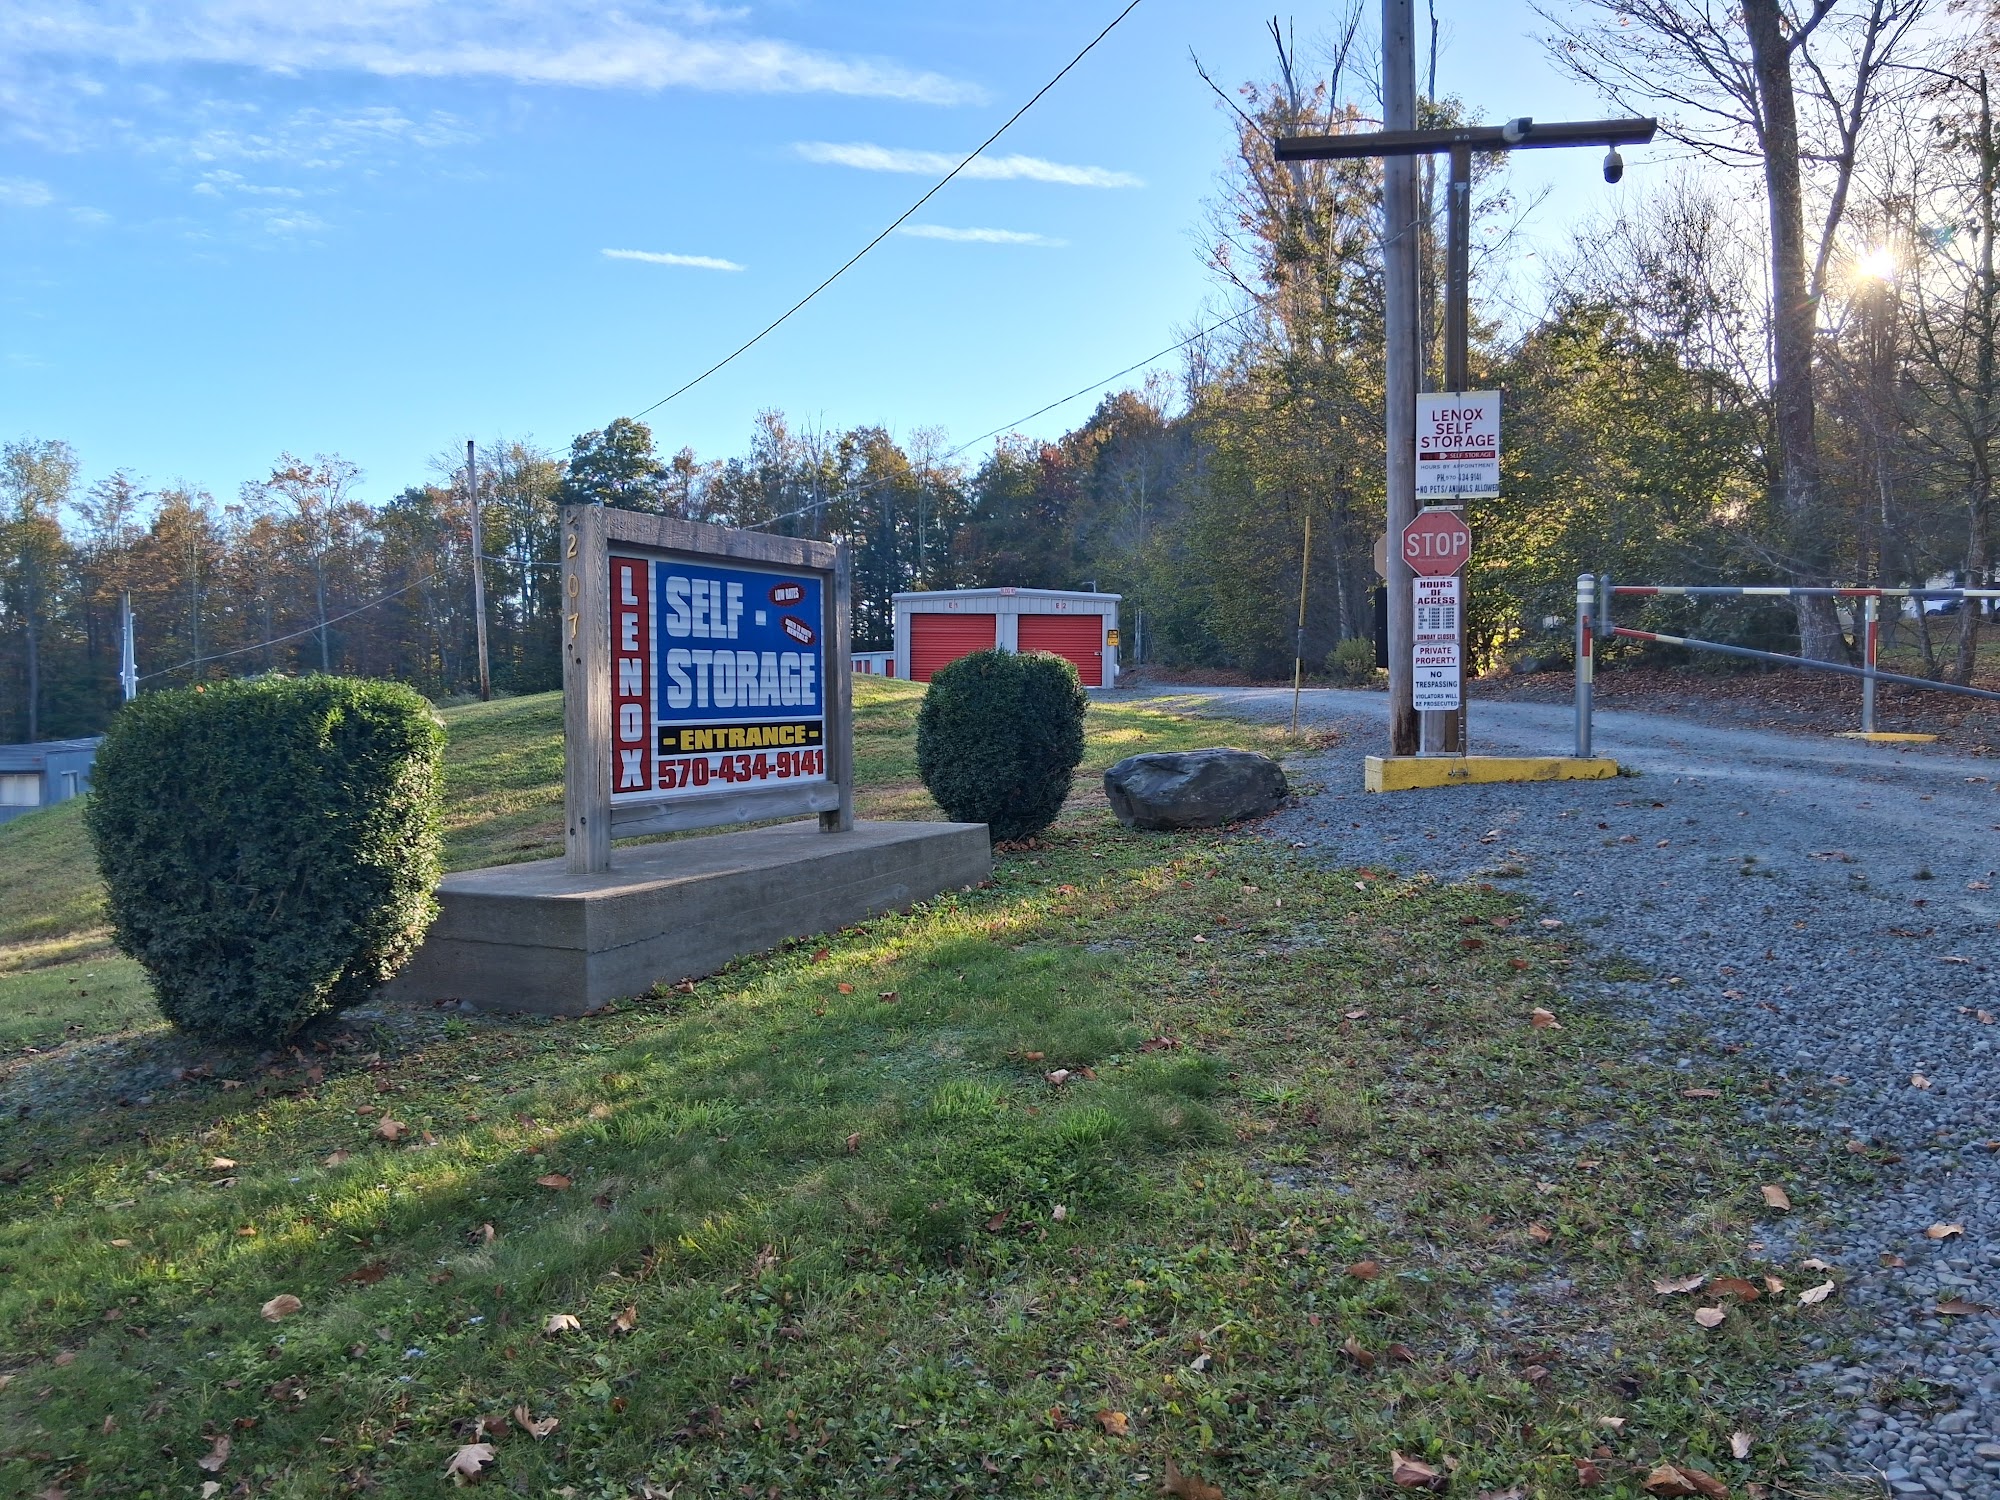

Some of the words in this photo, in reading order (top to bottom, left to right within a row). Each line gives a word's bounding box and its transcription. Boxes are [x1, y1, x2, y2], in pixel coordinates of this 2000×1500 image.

[1432, 408, 1484, 422] LENOX
[1435, 422, 1473, 435] SELF
[1420, 434, 1496, 449] STORAGE
[1465, 451, 1492, 459] STORAGE
[1419, 485, 1428, 494] NO
[1429, 484, 1473, 494] PETS/ANIMALS
[1474, 483, 1499, 492] ALLOWED
[1406, 531, 1467, 557] STOP
[1419, 580, 1453, 589] HOURS
[1417, 596, 1455, 605] ACCESS
[665, 575, 744, 640] SELF
[1419, 647, 1453, 655] PRIVATE
[1415, 656, 1457, 665] PROPERTY
[618, 566, 644, 788] LENOX
[666, 648, 816, 709] STORAGE
[1415, 681, 1458, 689] TRESPASSING
[680, 725, 807, 751] ENTRANCE
[657, 749, 825, 790] 570-434-9141
